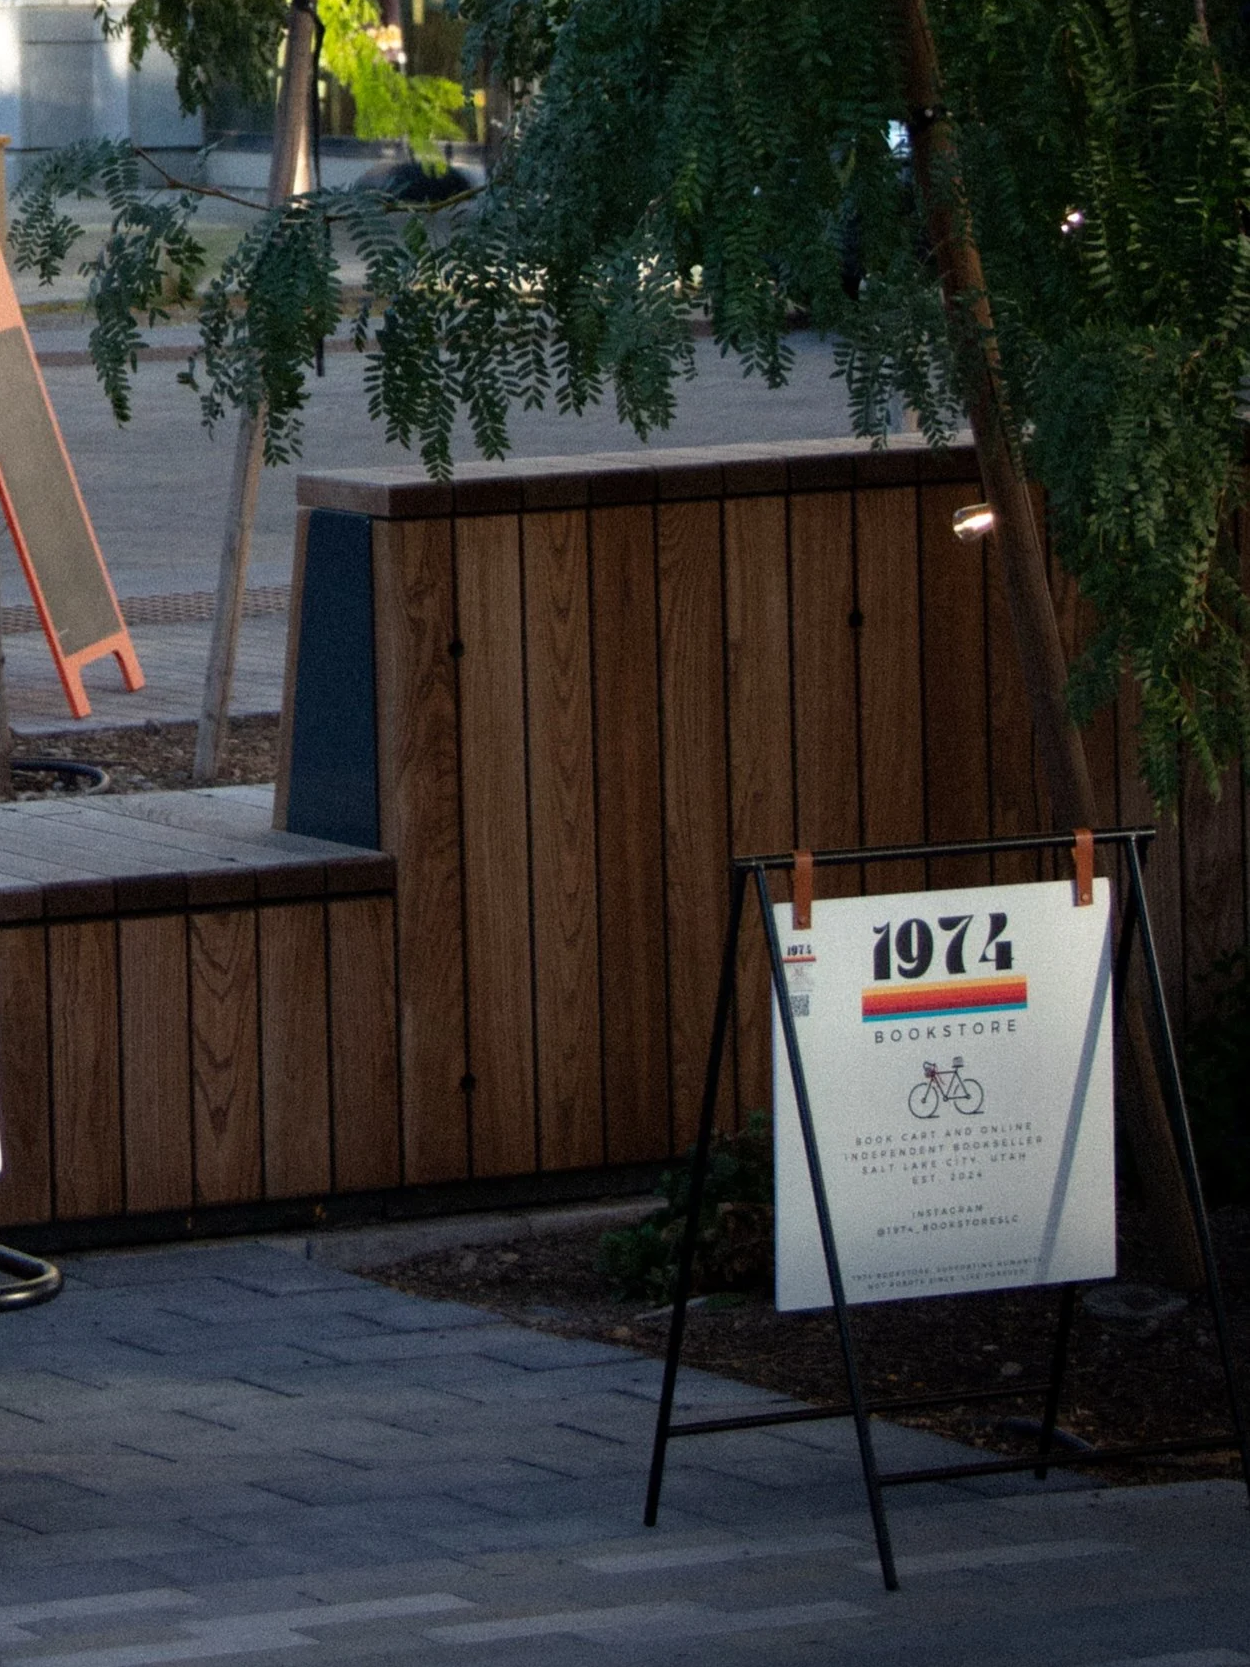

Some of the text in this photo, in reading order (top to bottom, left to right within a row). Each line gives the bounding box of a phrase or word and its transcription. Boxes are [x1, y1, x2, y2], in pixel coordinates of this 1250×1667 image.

[786, 943, 813, 956] 1974
[872, 912, 1014, 981] 1974
[874, 1019, 1018, 1044] BOOKSTORE
[855, 1122, 1032, 1146] BOOK CART AND ONLINE
[844, 1135, 1043, 1161] INDEPENDENT BOOKSELLER
[862, 1164, 895, 1175] SALT
[903, 1160, 937, 1172] LAKE
[990, 1152, 1026, 1163] UTAH
[950, 1170, 983, 1182] 2024
[912, 1204, 984, 1219] INSTAGRAM
[876, 1214, 1019, 1238] @1974_BOOKSTORESLC
